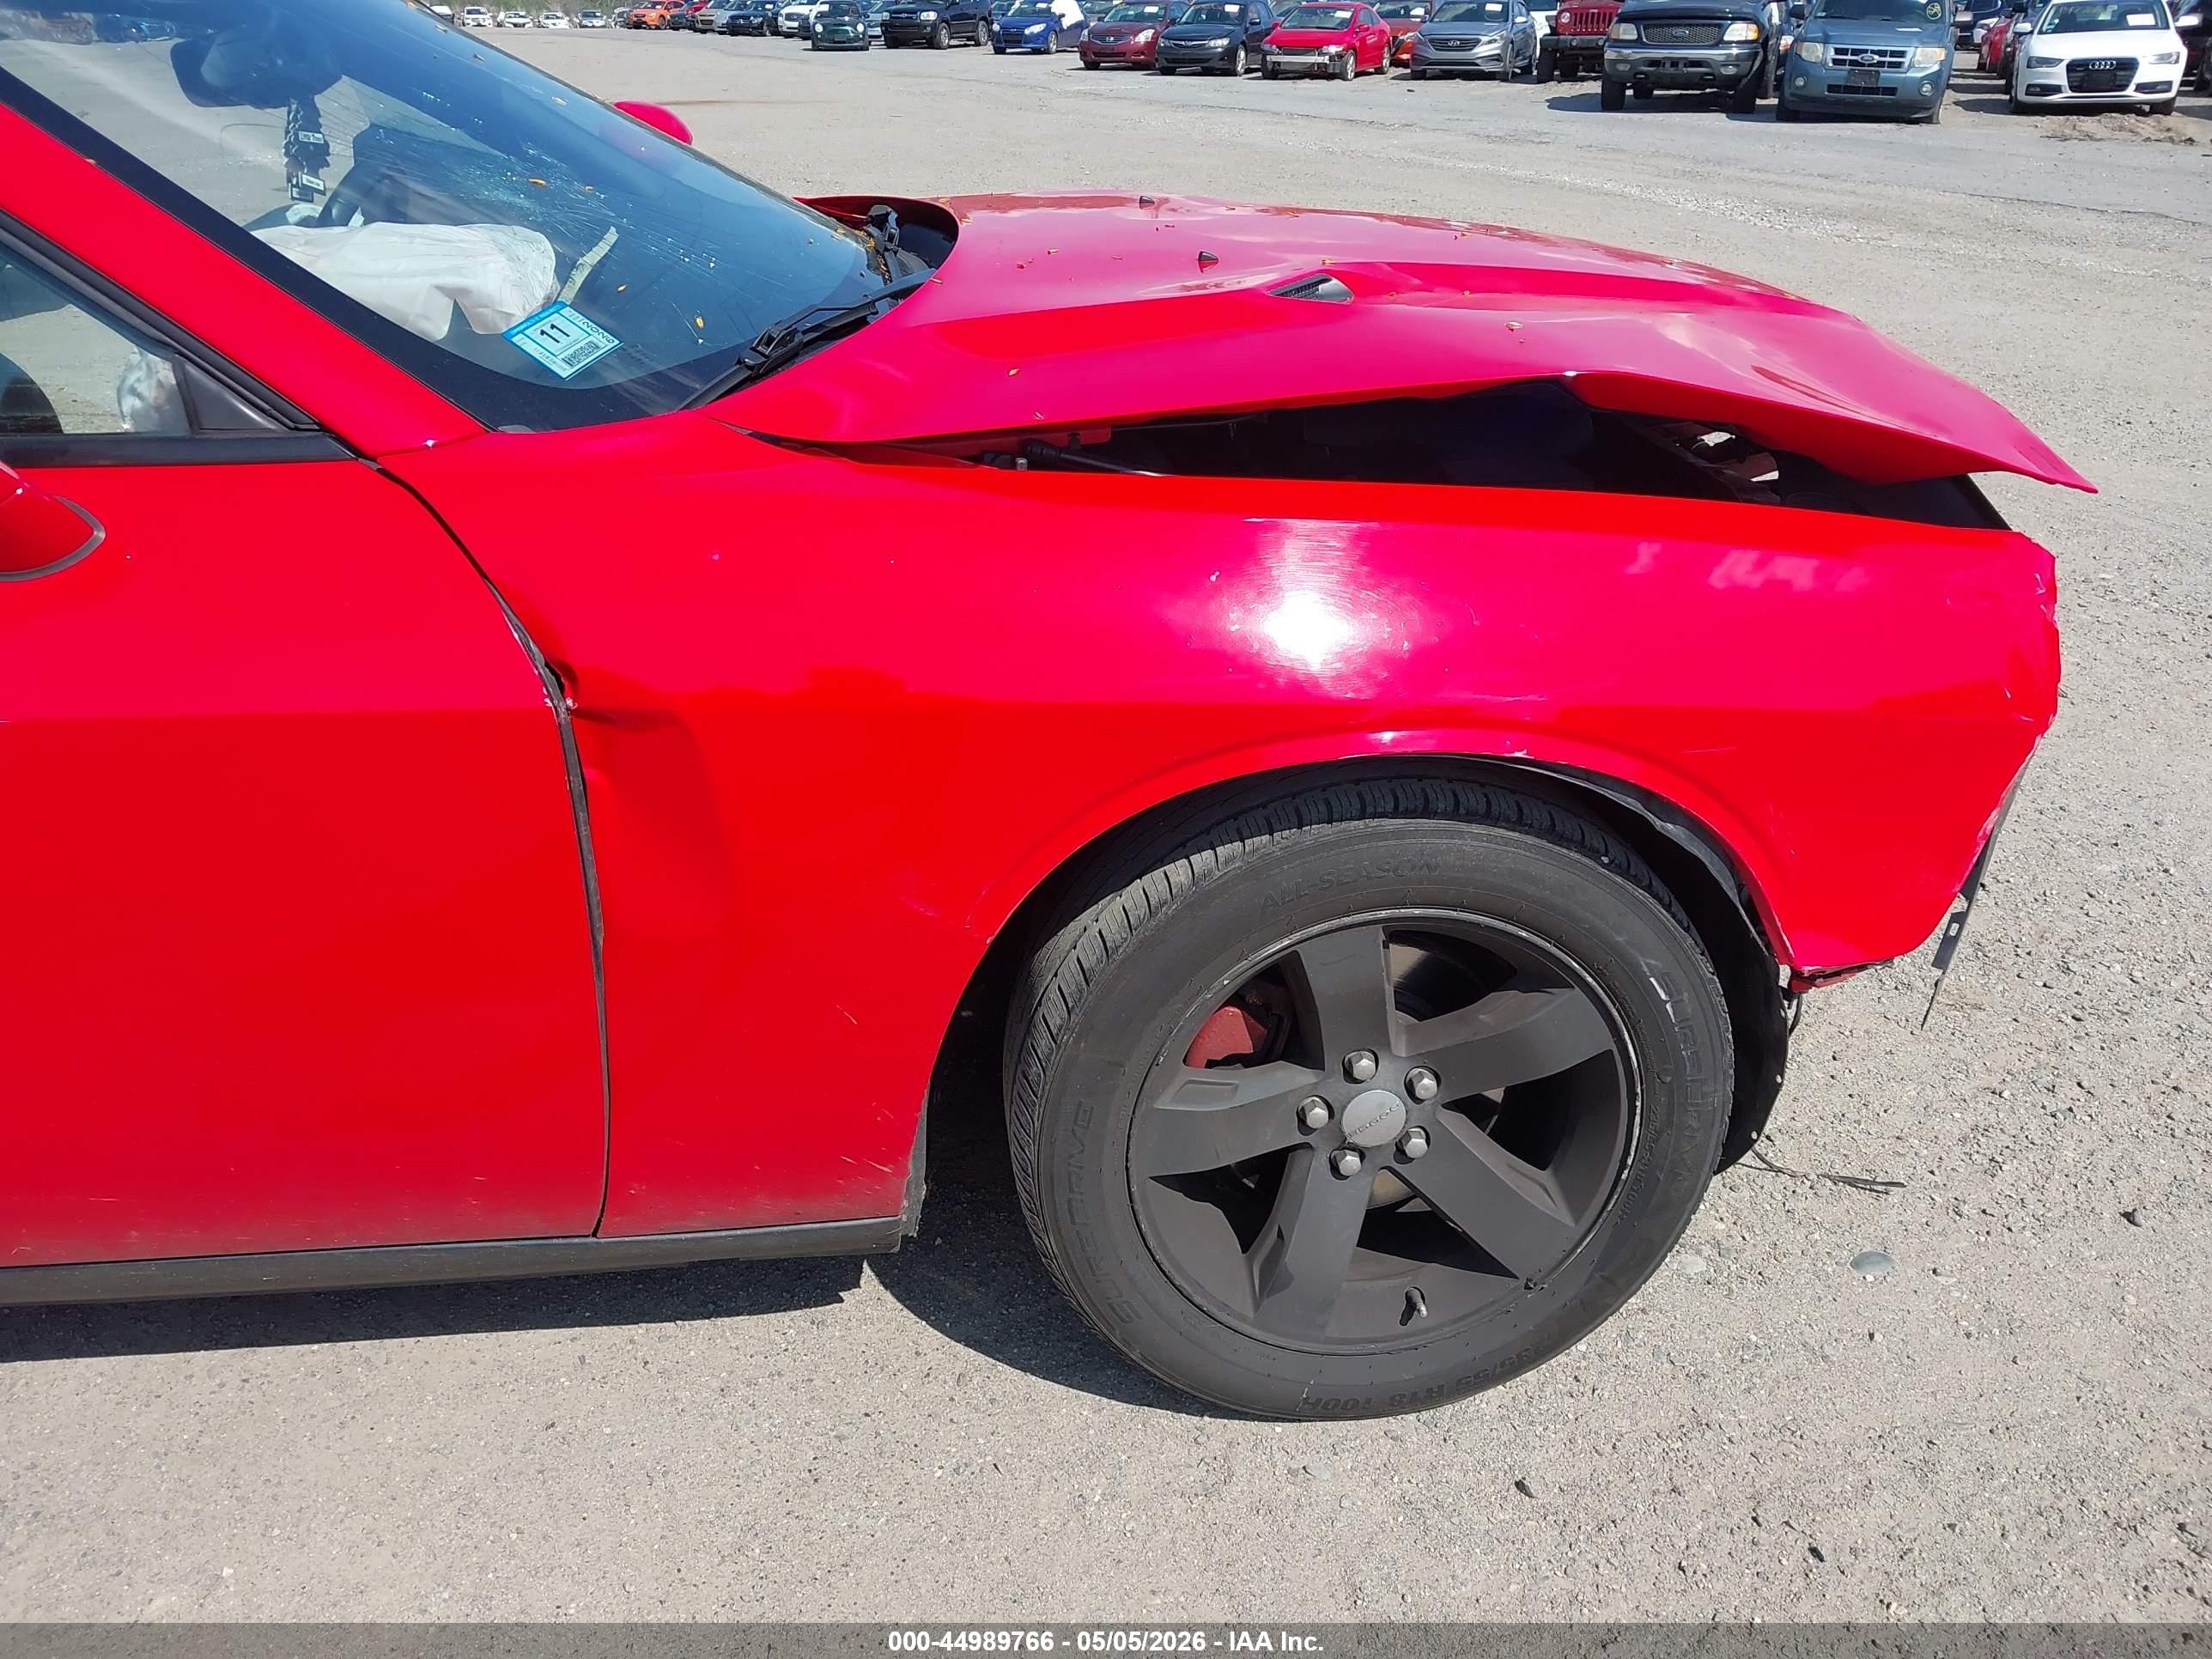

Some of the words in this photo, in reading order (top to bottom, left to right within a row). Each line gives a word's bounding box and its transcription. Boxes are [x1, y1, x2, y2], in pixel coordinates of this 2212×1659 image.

[539, 323, 571, 343] 11
[582, 321, 615, 344] 2026
[1065, 1098, 1144, 1325] SUREDRIVE
